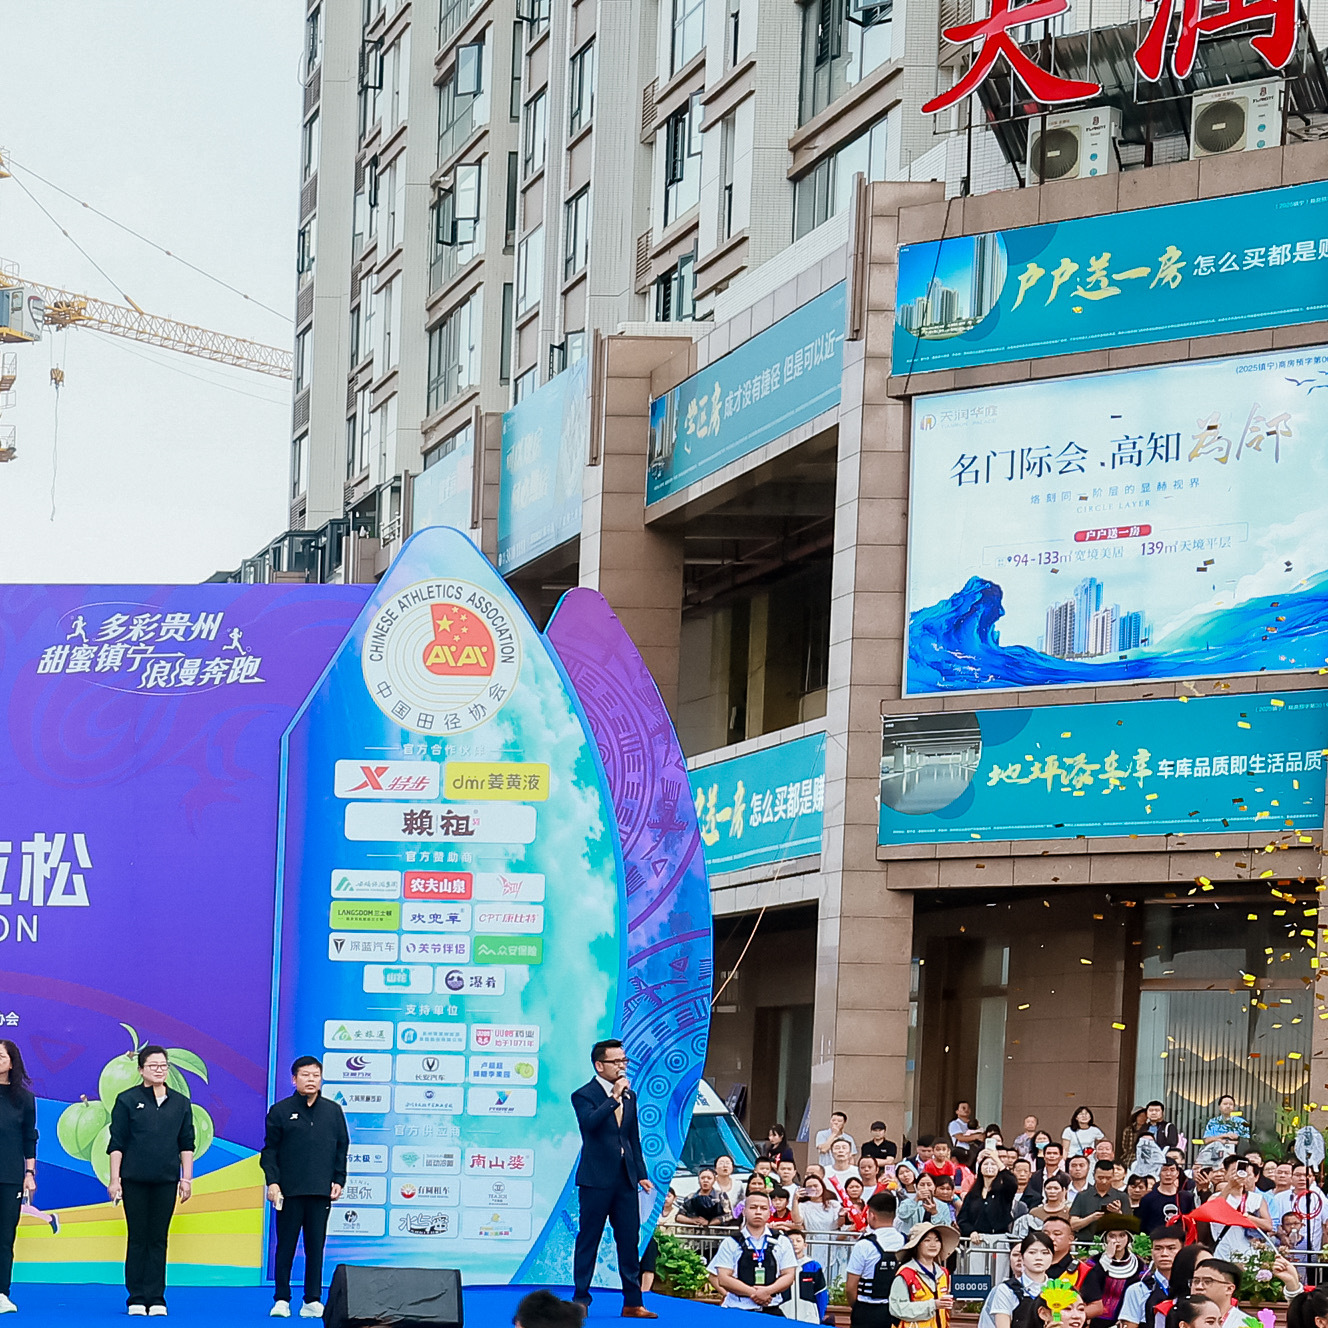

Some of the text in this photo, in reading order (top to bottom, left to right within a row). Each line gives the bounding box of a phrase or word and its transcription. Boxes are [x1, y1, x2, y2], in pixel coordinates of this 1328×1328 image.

[94, 612, 224, 643] 多彩贵州
[369, 584, 515, 664] CHINESE ATHLETICS ASSOCIATION
[36, 643, 186, 674] 甜蜜镇宁
[137, 656, 266, 689] 浪漫奔跑
[375, 681, 507, 731] 中国田径协会
[488, 773, 540, 791] 姜黄液
[410, 878, 466, 893] 农夫山泉
